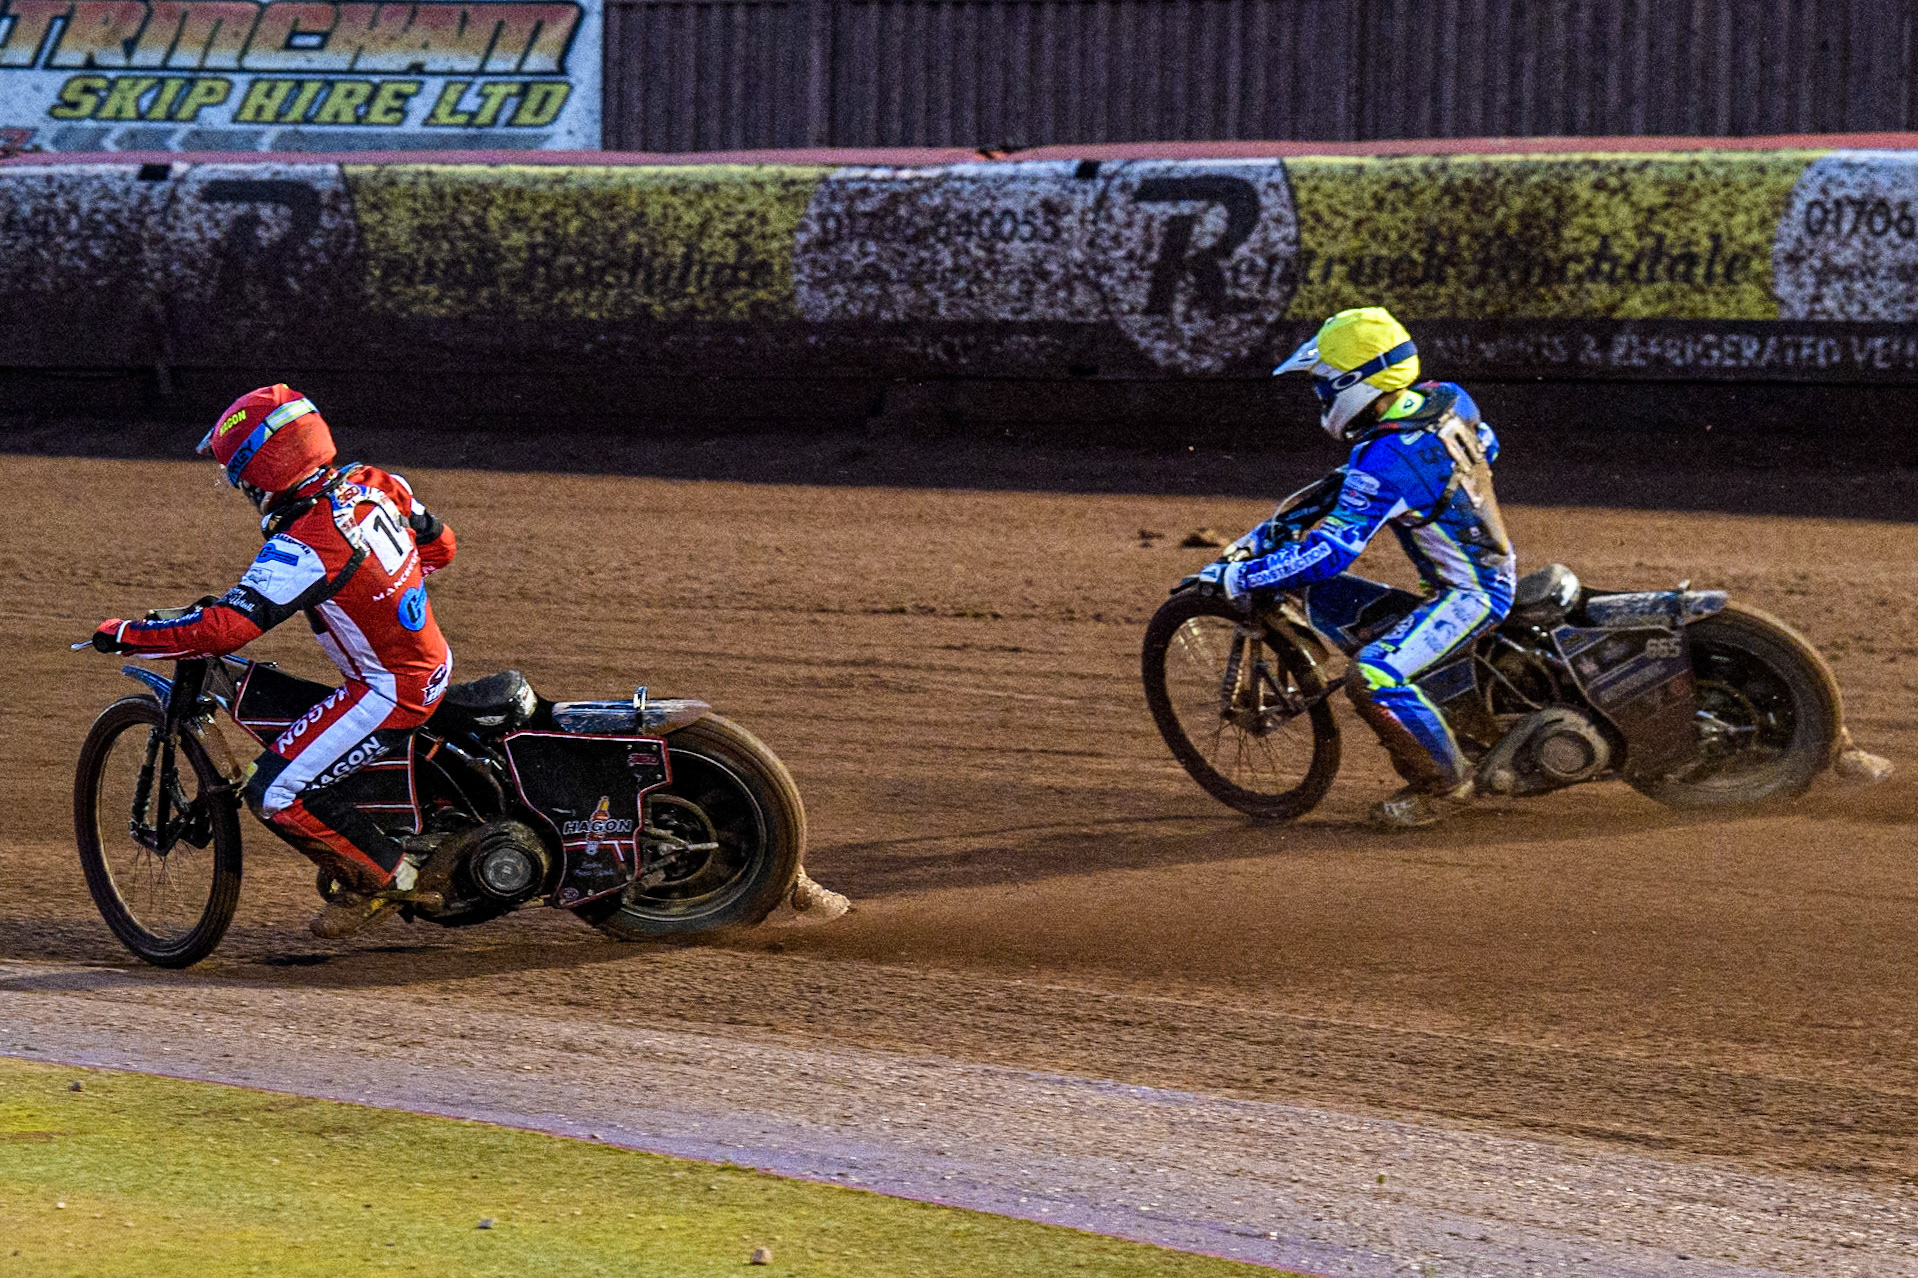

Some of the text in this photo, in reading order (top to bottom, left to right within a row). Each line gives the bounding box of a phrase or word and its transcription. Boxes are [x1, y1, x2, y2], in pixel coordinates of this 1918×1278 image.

[49, 75, 574, 127] SKIP HIRE LTD
[563, 819, 634, 835] HAGON
